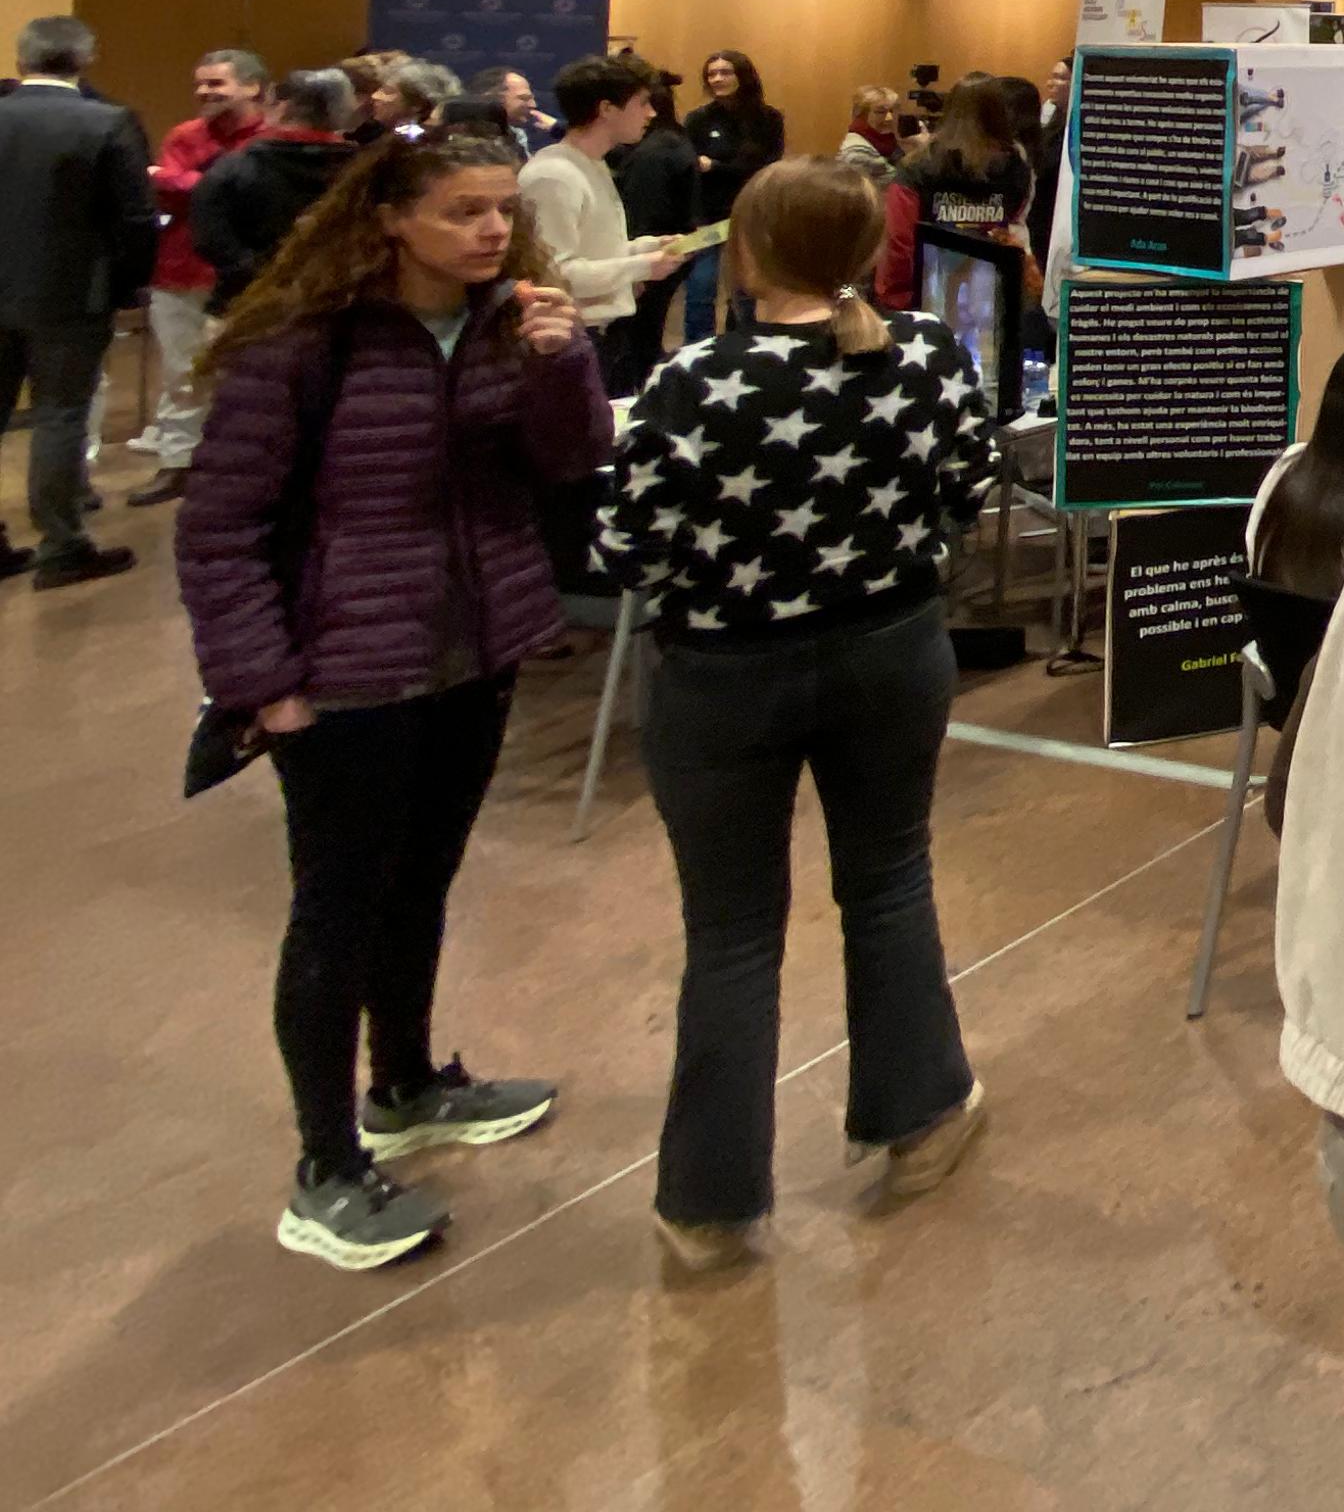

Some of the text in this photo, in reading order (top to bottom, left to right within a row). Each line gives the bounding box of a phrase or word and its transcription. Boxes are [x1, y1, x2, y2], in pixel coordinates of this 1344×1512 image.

[1130, 552, 1244, 577] El que he après és
[1124, 575, 1231, 601] problema ens he
[1129, 604, 1158, 618] amb
[1161, 599, 1202, 613] calma,
[1140, 619, 1192, 638] possible
[1202, 616, 1218, 627] en
[1221, 613, 1242, 625] cap
[1181, 653, 1228, 671] Gabriel
